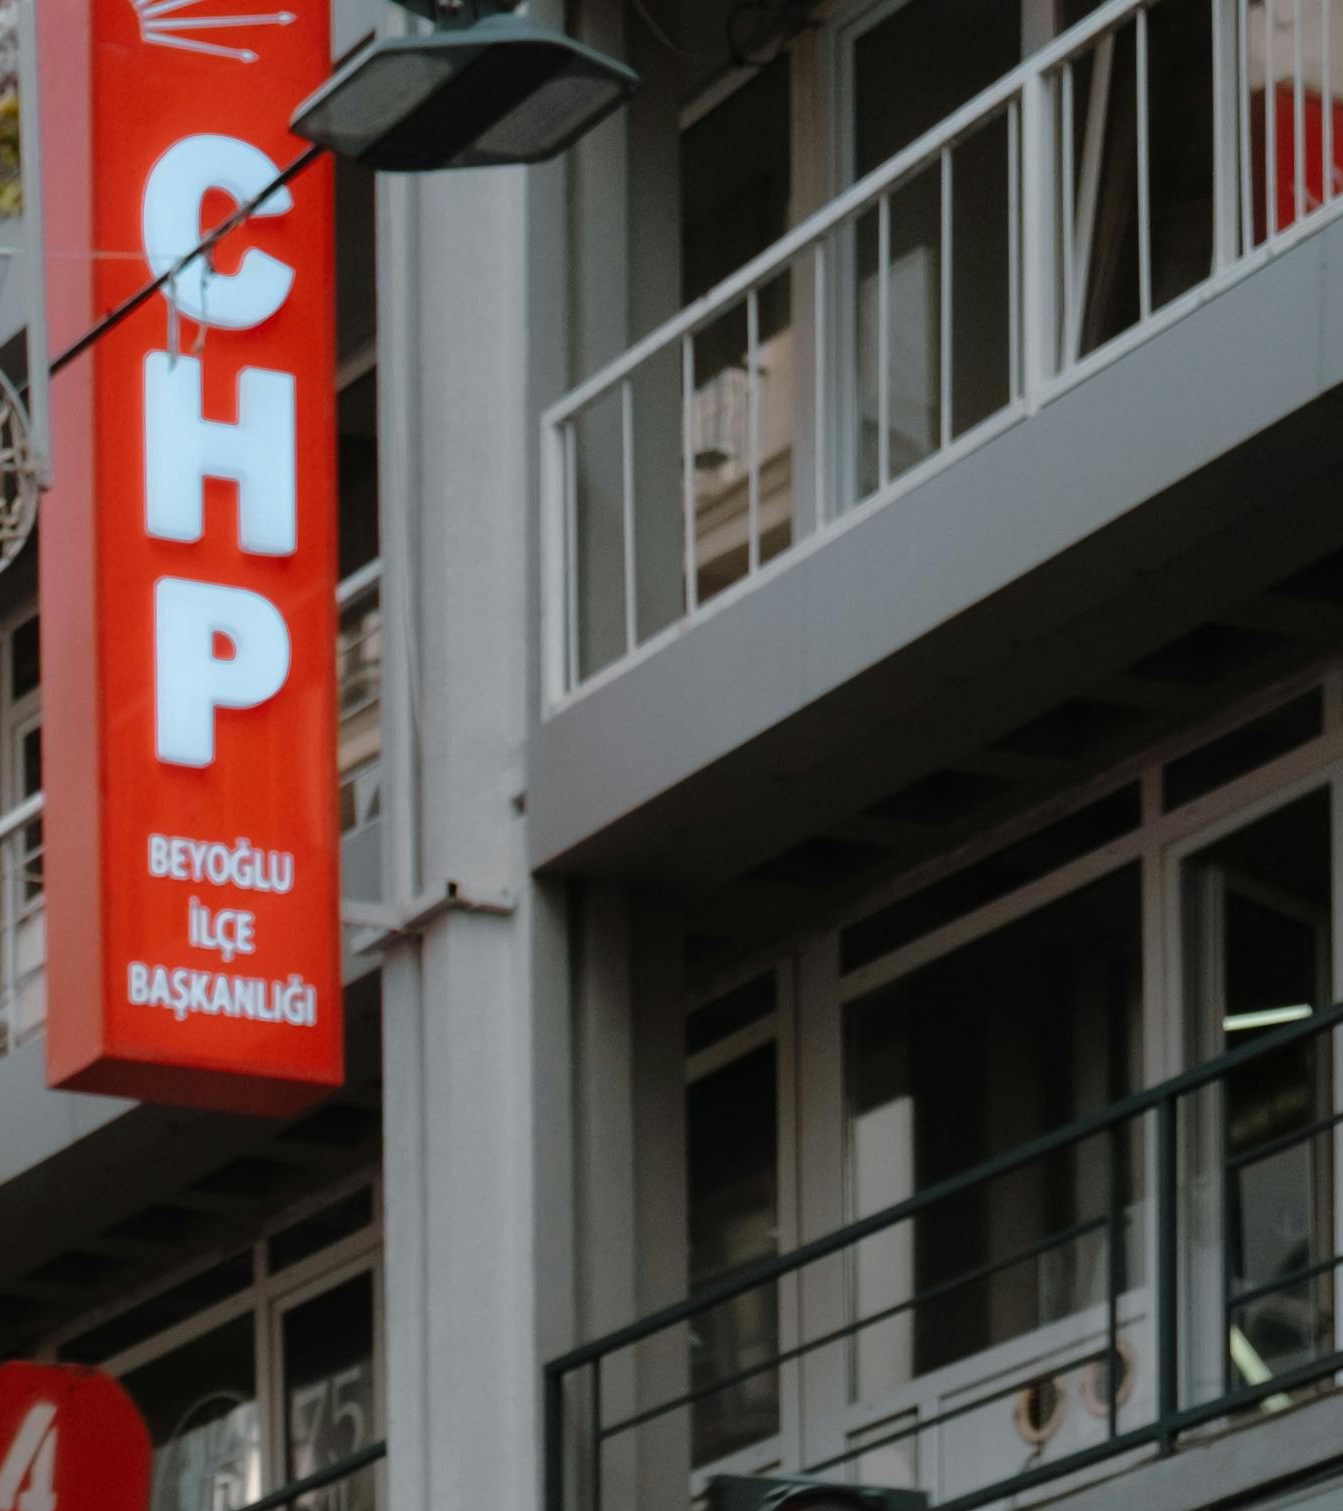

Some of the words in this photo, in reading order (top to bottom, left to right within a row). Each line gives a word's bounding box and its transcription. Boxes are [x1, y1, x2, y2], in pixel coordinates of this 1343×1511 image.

[141, 134, 299, 770] CHP
[148, 835, 294, 895] BEYOĞLU
[188, 897, 255, 957] İLÇE
[127, 958, 318, 1028] BAŞKANLIĞI
